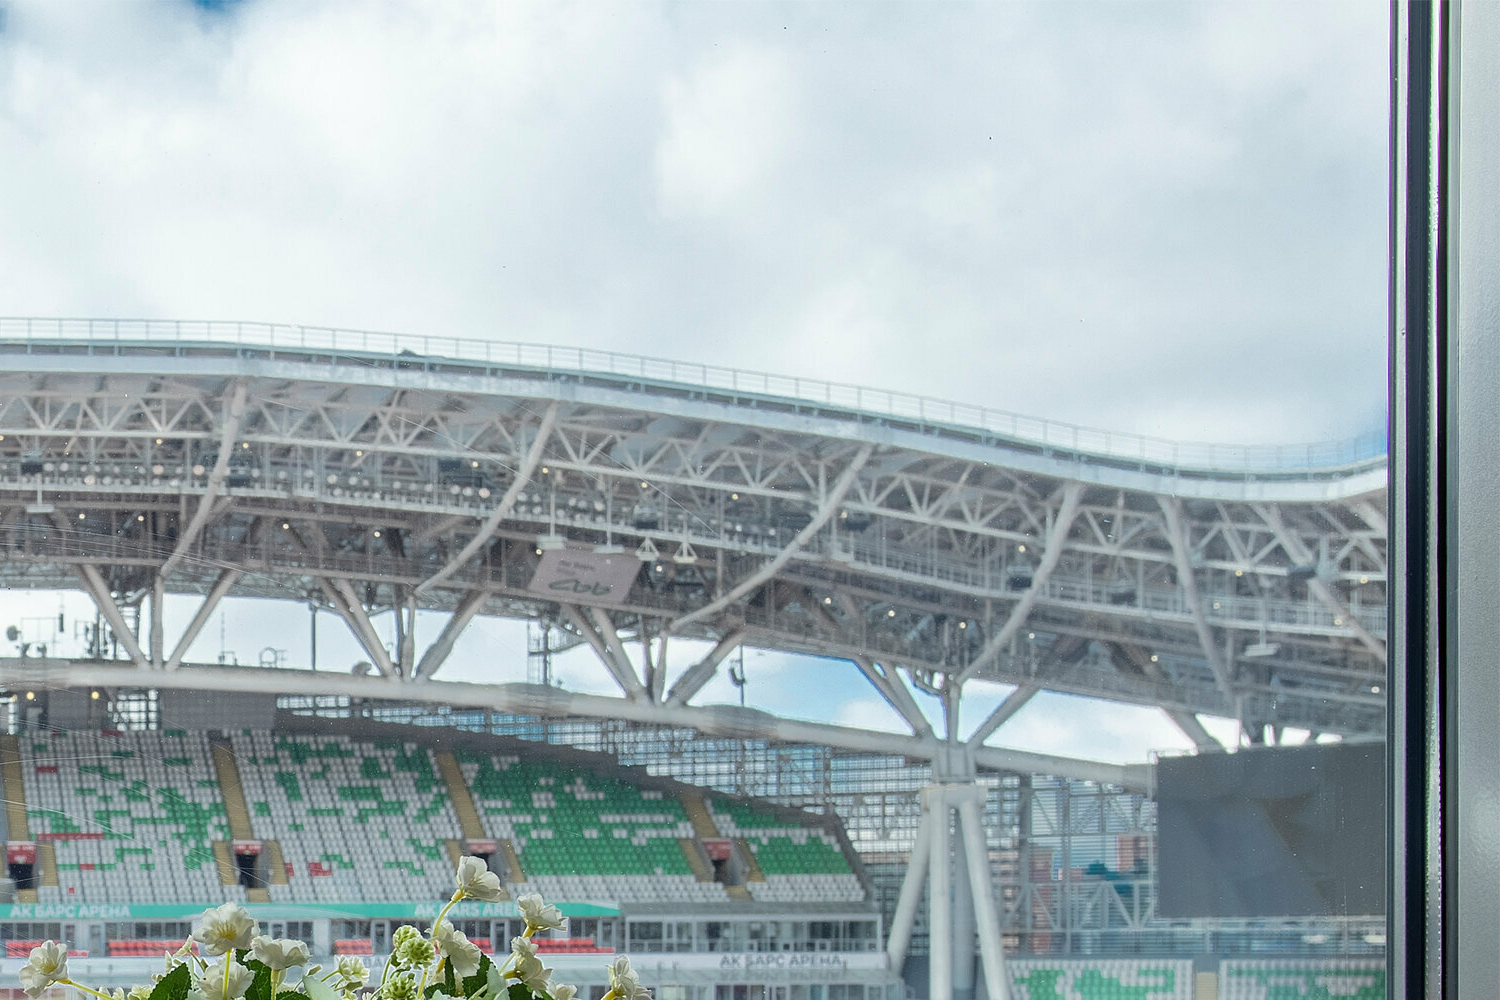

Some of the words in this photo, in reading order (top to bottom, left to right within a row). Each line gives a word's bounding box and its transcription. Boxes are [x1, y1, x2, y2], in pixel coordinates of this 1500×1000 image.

[9, 904, 32, 918] АК
[34, 904, 77, 918] БАРС
[78, 904, 132, 918] АРЕНА
[414, 903, 437, 918] AK
[719, 954, 742, 969] АК
[745, 954, 785, 969] БАРС
[788, 954, 843, 969] АРЕНА
